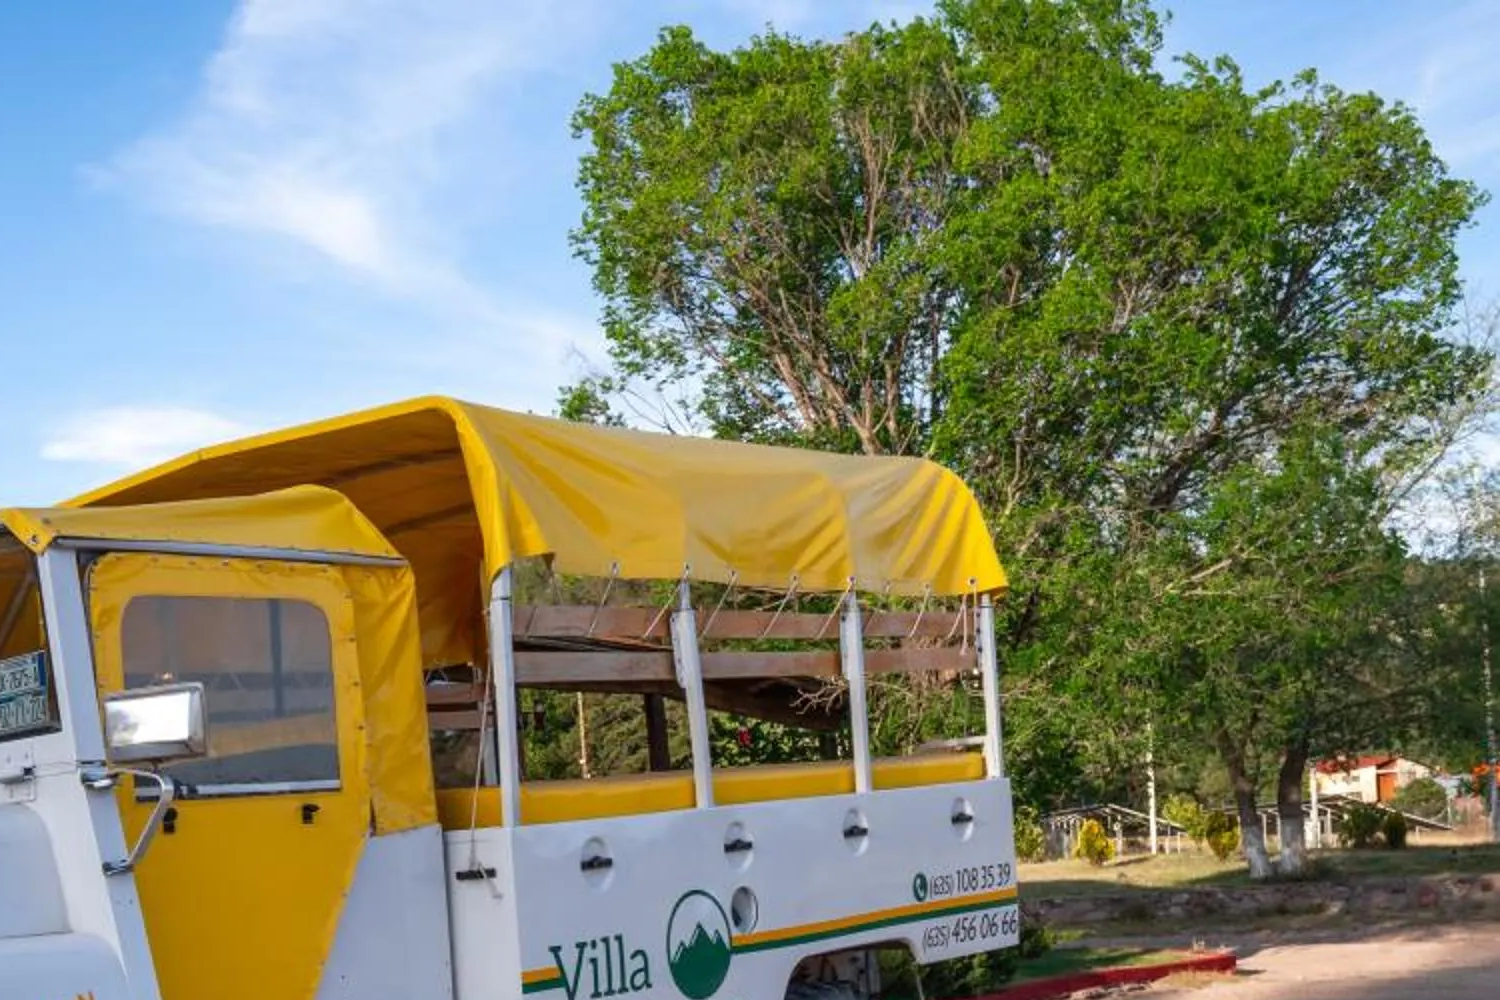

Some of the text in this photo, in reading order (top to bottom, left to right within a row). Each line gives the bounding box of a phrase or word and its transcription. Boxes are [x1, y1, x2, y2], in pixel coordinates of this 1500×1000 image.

[956, 867, 979, 893] 108
[981, 865, 995, 889] 35
[998, 863, 1011, 886] 39
[951, 916, 977, 944] 456
[980, 912, 999, 940] 06
[1002, 909, 1017, 935] 66
